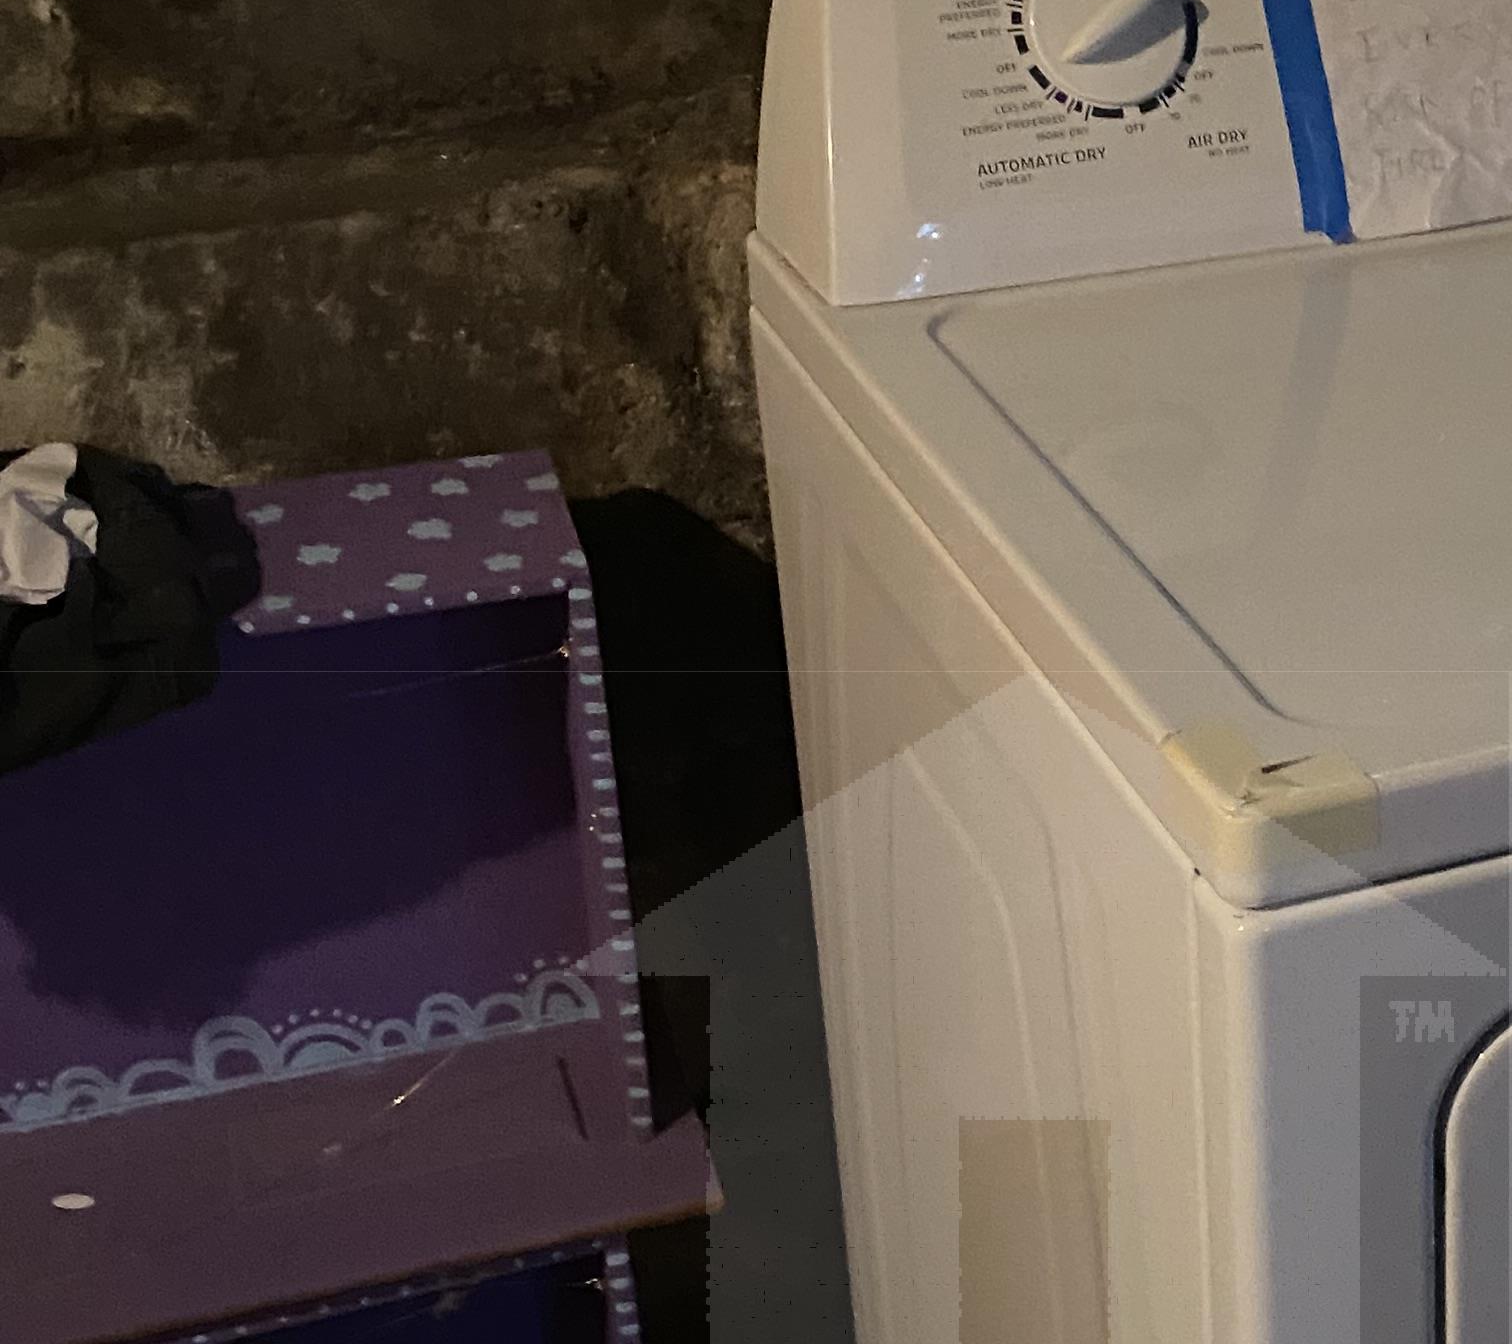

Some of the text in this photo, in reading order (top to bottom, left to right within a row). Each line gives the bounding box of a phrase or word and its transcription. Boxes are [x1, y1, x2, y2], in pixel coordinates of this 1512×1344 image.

[1124, 122, 1147, 135] OFF
[1187, 128, 1249, 149] AIR DRY
[977, 146, 1108, 178] AUTOMATIC DRY
